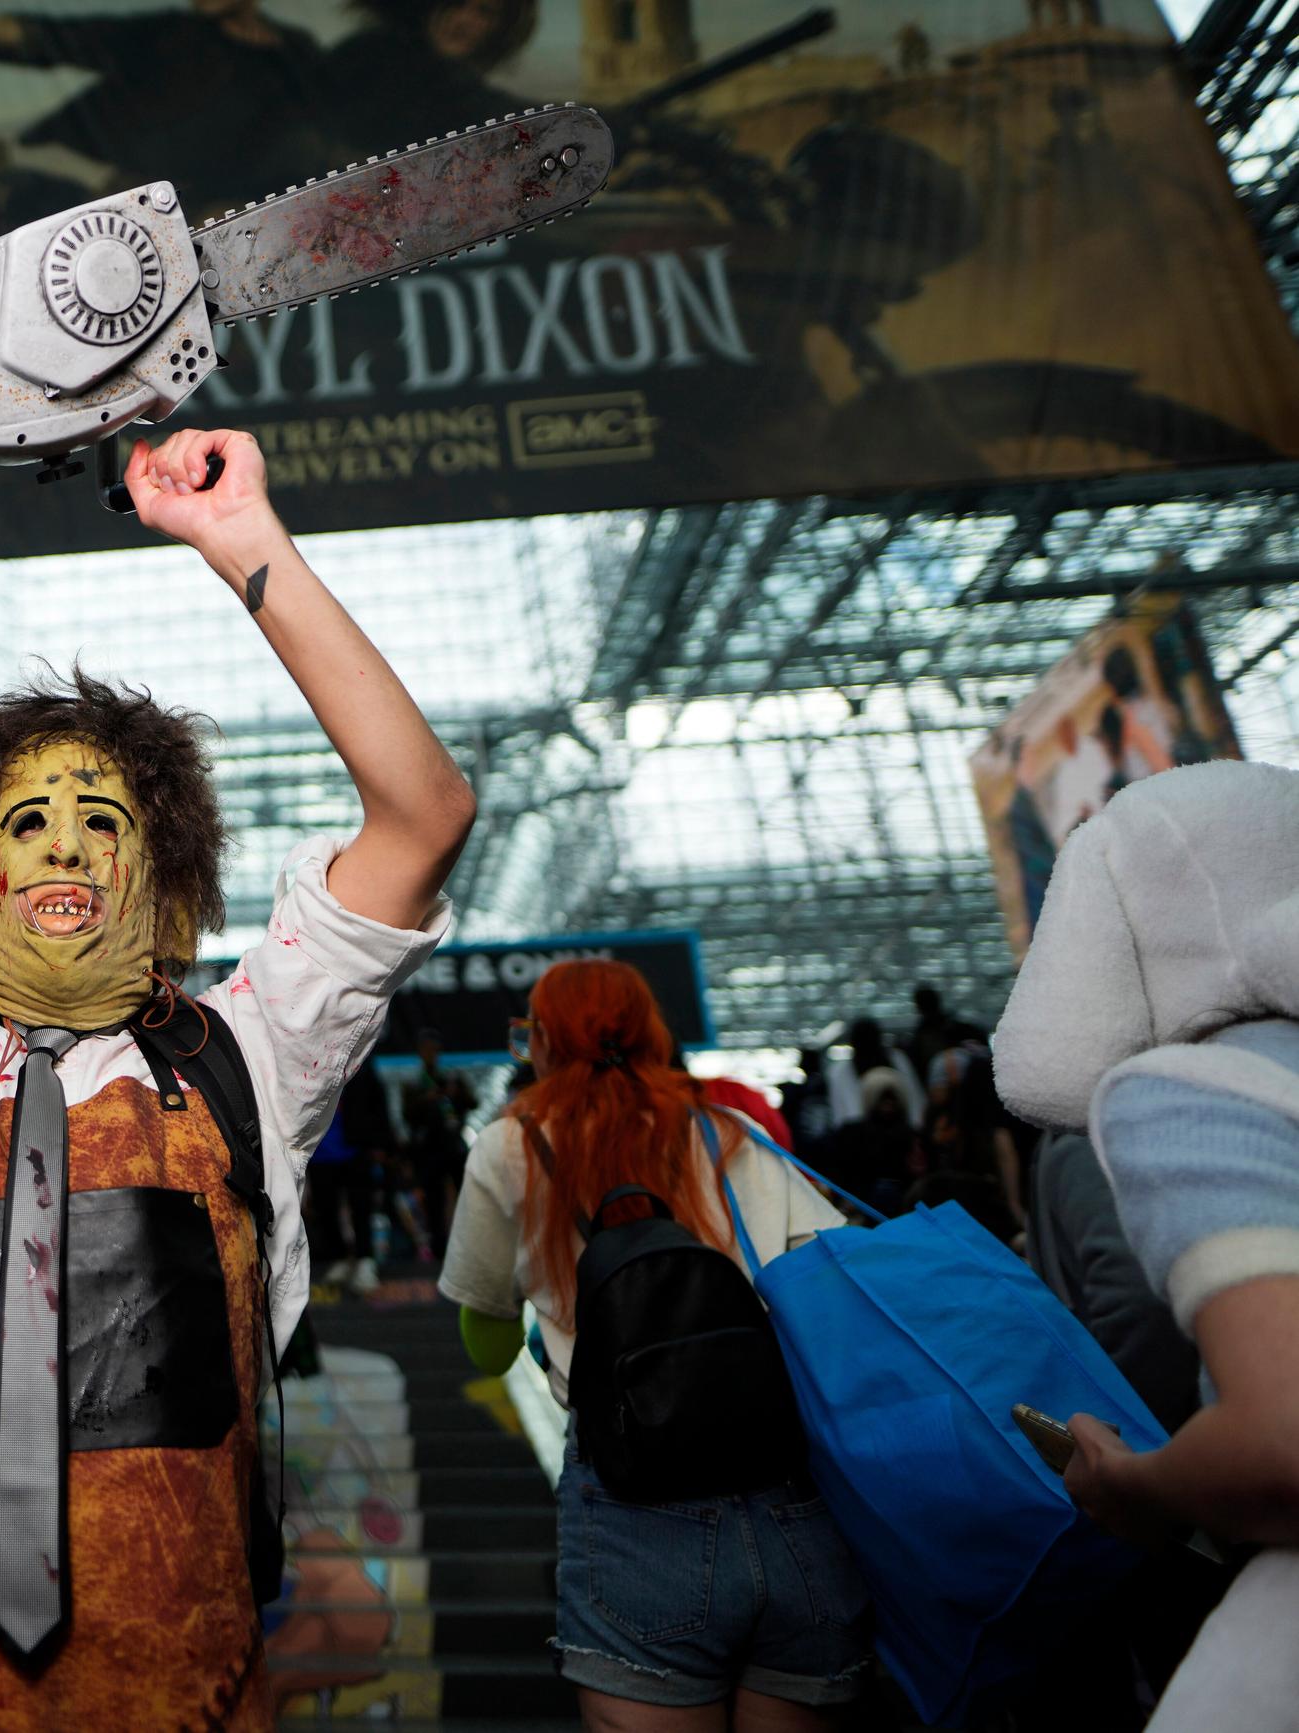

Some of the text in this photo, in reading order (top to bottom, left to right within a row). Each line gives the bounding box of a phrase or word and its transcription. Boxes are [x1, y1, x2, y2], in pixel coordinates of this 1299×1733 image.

[400, 243, 757, 392] DIXON
[249, 403, 497, 453] TREAMING
[267, 440, 499, 487] SIVELY ON
[463, 952, 497, 992] &
